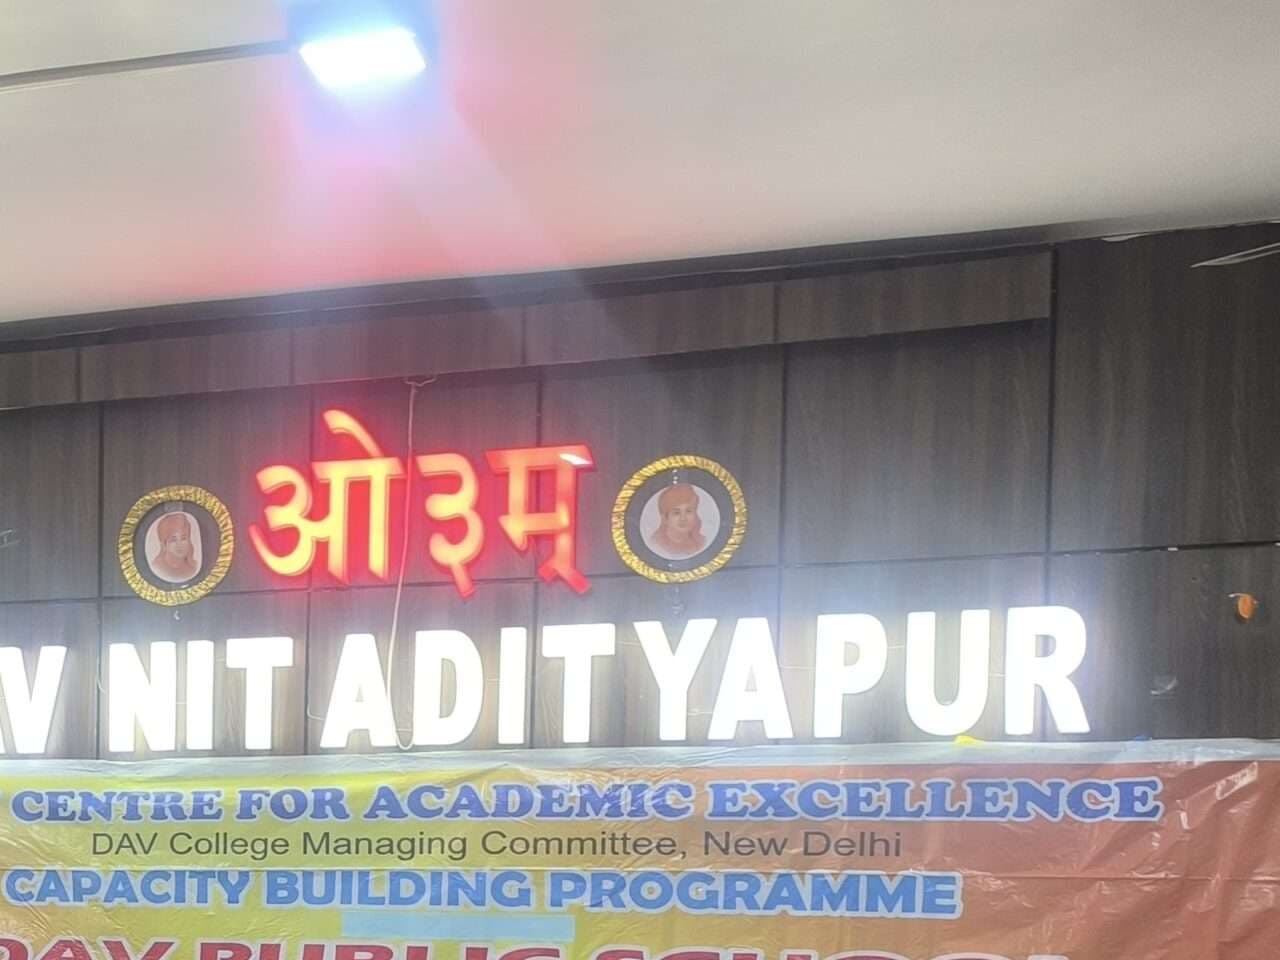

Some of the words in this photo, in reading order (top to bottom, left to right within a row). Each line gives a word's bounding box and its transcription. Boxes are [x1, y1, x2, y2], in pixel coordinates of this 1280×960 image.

[108, 636, 294, 753] NIT
[320, 605, 1091, 750] ADITYAPUR
[11, 789, 223, 822] CENTRE
[235, 786, 351, 821] FOR
[363, 782, 694, 820] ACADEMIC
[707, 779, 1162, 820] EXCELLENCE
[91, 831, 158, 856] DAV
[169, 831, 290, 861] College
[302, 830, 468, 862] Managing
[480, 830, 688, 860] Committee,
[703, 830, 788, 857] New
[803, 831, 902, 858] Delhi
[4, 867, 251, 905] CAPACITY
[265, 869, 532, 908] BUILDING
[549, 870, 958, 916] PROGRAMME
